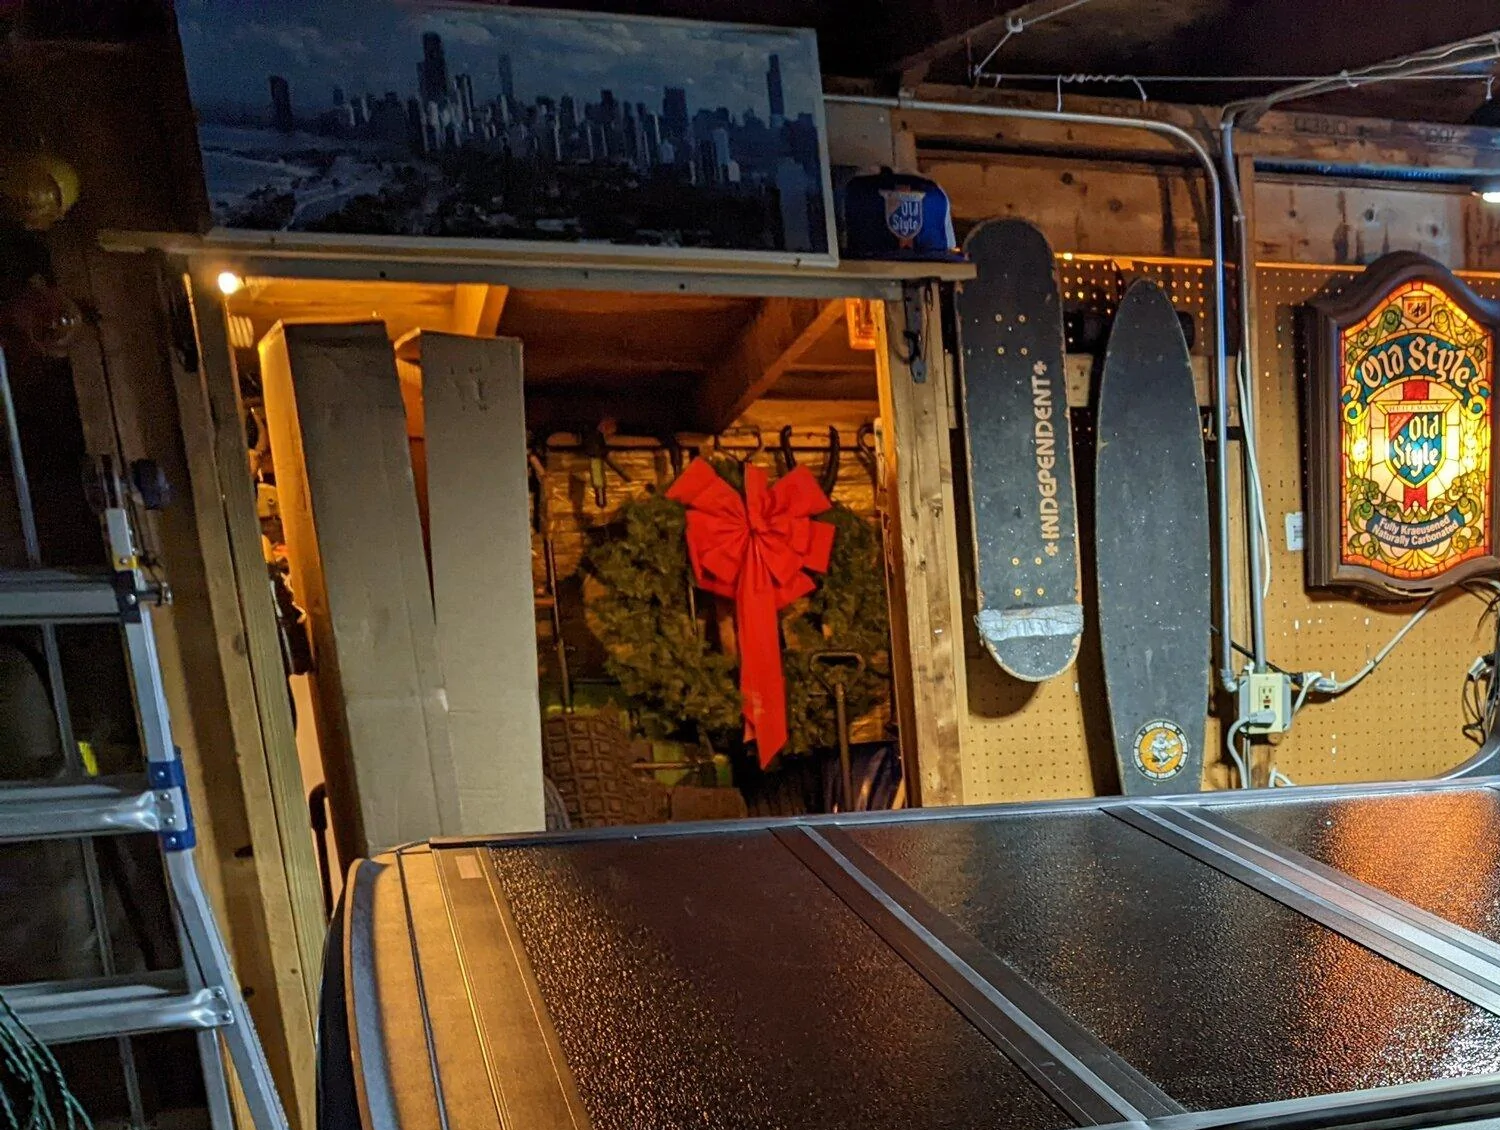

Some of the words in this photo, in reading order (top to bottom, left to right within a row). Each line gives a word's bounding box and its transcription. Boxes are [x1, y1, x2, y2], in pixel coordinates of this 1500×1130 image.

[901, 201, 918, 217] Old
[1361, 344, 1405, 388] Old
[1408, 336, 1470, 388] Style
[1409, 414, 1439, 441] Old
[1031, 375, 1060, 540] INDEPENDENT
[1392, 435, 1439, 477] Style
[1372, 523, 1410, 547] Naturally
[1410, 519, 1459, 545] Carbonated
[1380, 517, 1399, 535] Fully
[1400, 514, 1451, 536] Kraeusened
